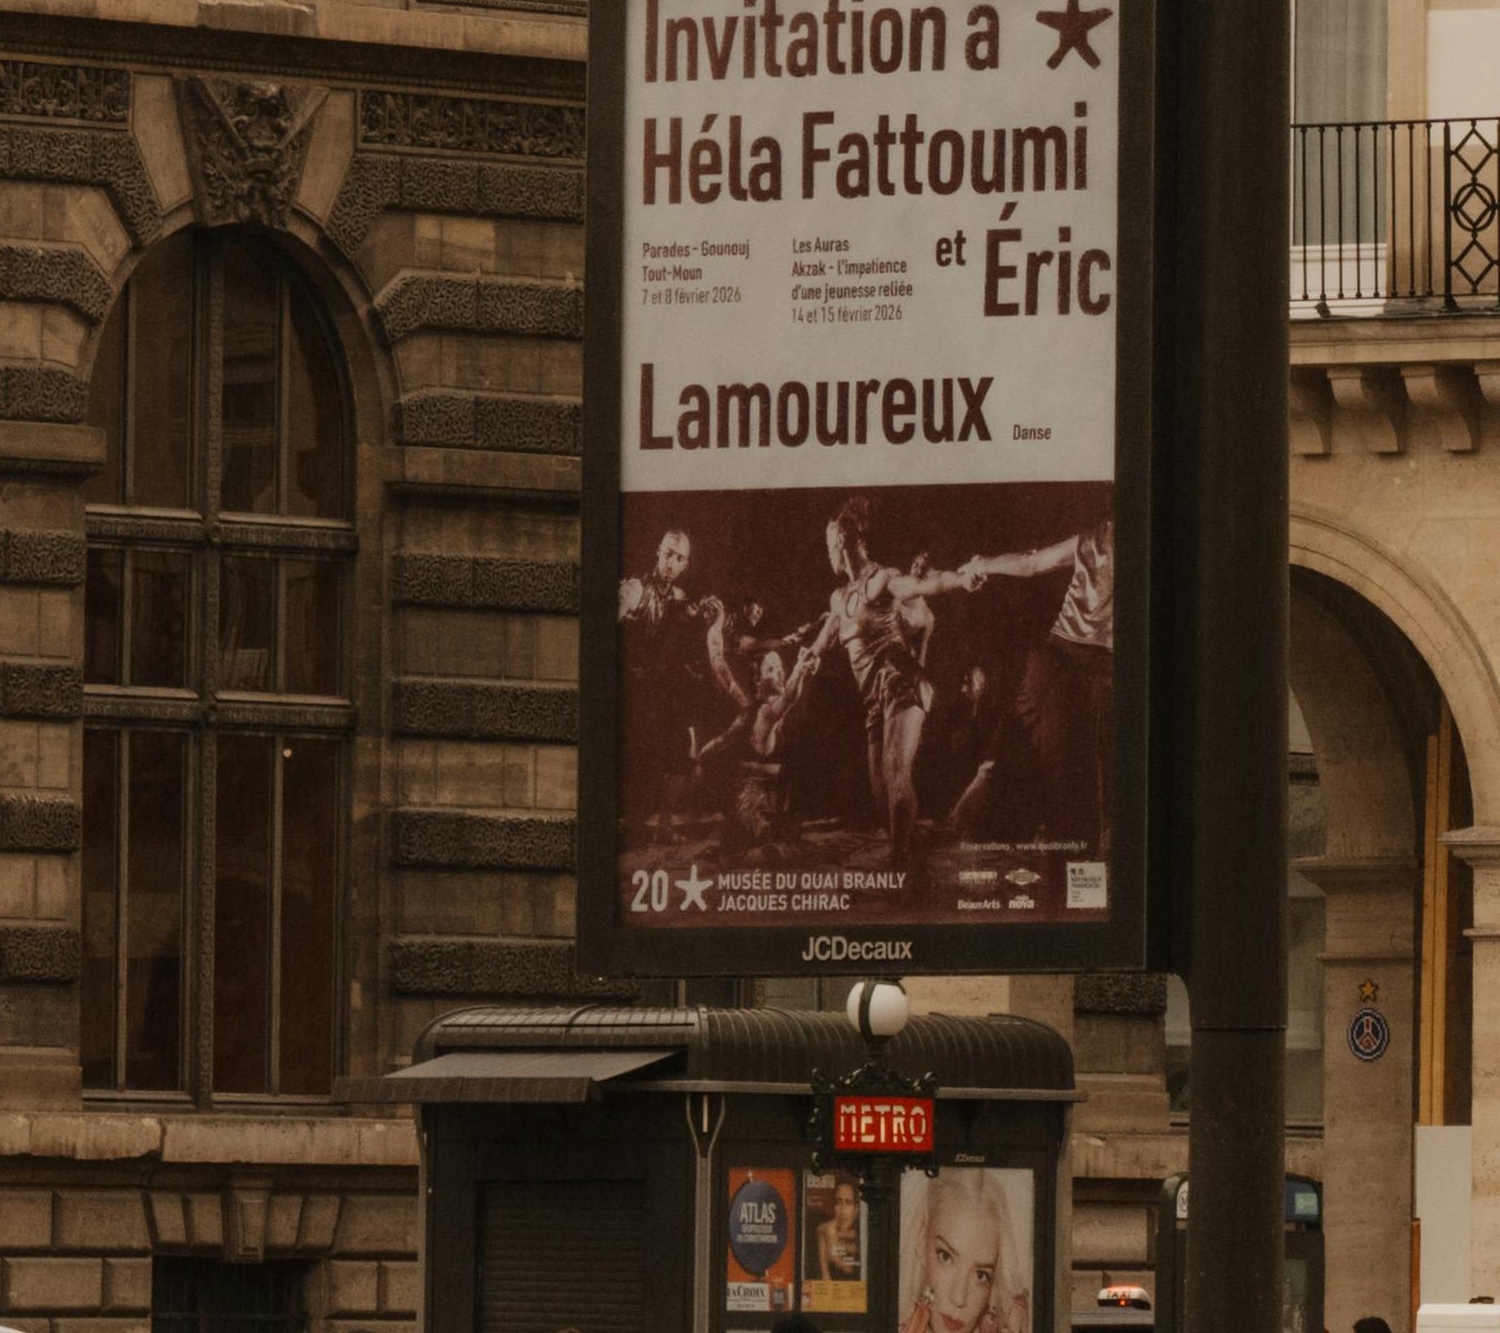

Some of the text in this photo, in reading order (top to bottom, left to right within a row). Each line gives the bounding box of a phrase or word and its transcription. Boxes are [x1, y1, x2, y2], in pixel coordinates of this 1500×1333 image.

[642, 100, 1088, 206] Héla Fattoumi
[642, 241, 691, 259] Parades
[700, 239, 750, 260] Gounouj
[792, 236, 850, 254] Les Auras
[791, 261, 826, 278] Akzak
[837, 258, 908, 278] l'impatience
[935, 201, 1112, 318] et Éric
[642, 264, 703, 282] Tout-Moun
[641, 285, 742, 306] 7 et 8 février 2026
[791, 281, 914, 304] d'une jeunesse reliée
[791, 303, 903, 324] 14 et 15 février 2026
[638, 363, 994, 452] Lamoureux
[1012, 424, 1052, 442] Danse
[631, 869, 669, 912] 20
[717, 869, 906, 891] MUSÉE DU QUAI BRANLY
[717, 893, 850, 912] JACQUES CHIRAC
[801, 936, 913, 961] JCDecaux
[839, 1103, 928, 1144] METRO
[739, 1201, 777, 1224] ATLAS
